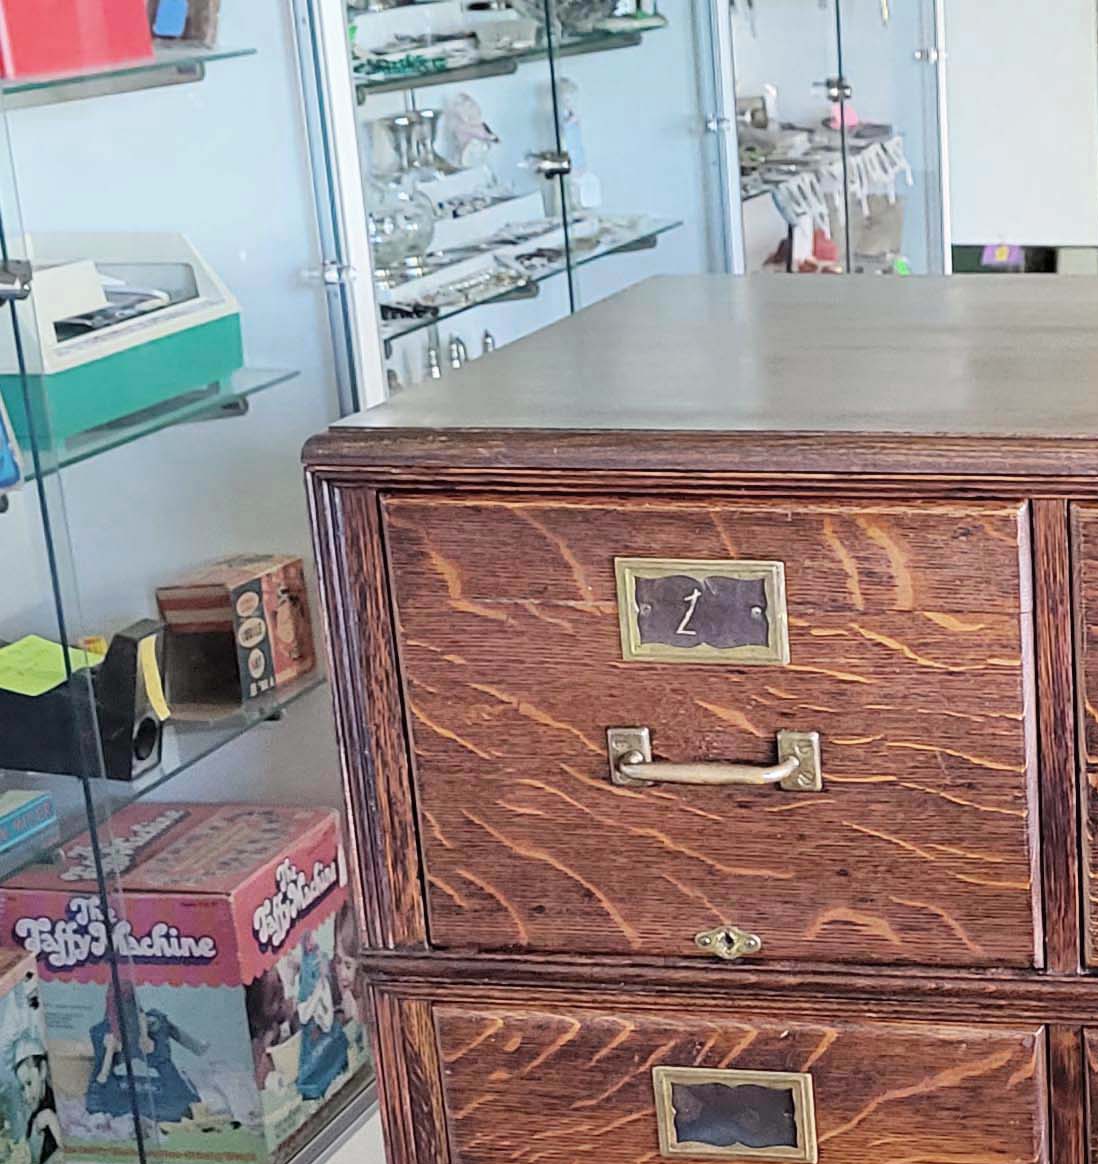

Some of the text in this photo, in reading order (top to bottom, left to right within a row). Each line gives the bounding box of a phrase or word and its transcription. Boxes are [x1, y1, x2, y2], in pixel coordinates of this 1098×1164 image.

[69, 897, 117, 925] The
[253, 893, 291, 946] Taffy
[15, 917, 217, 966] Taffy Machine
